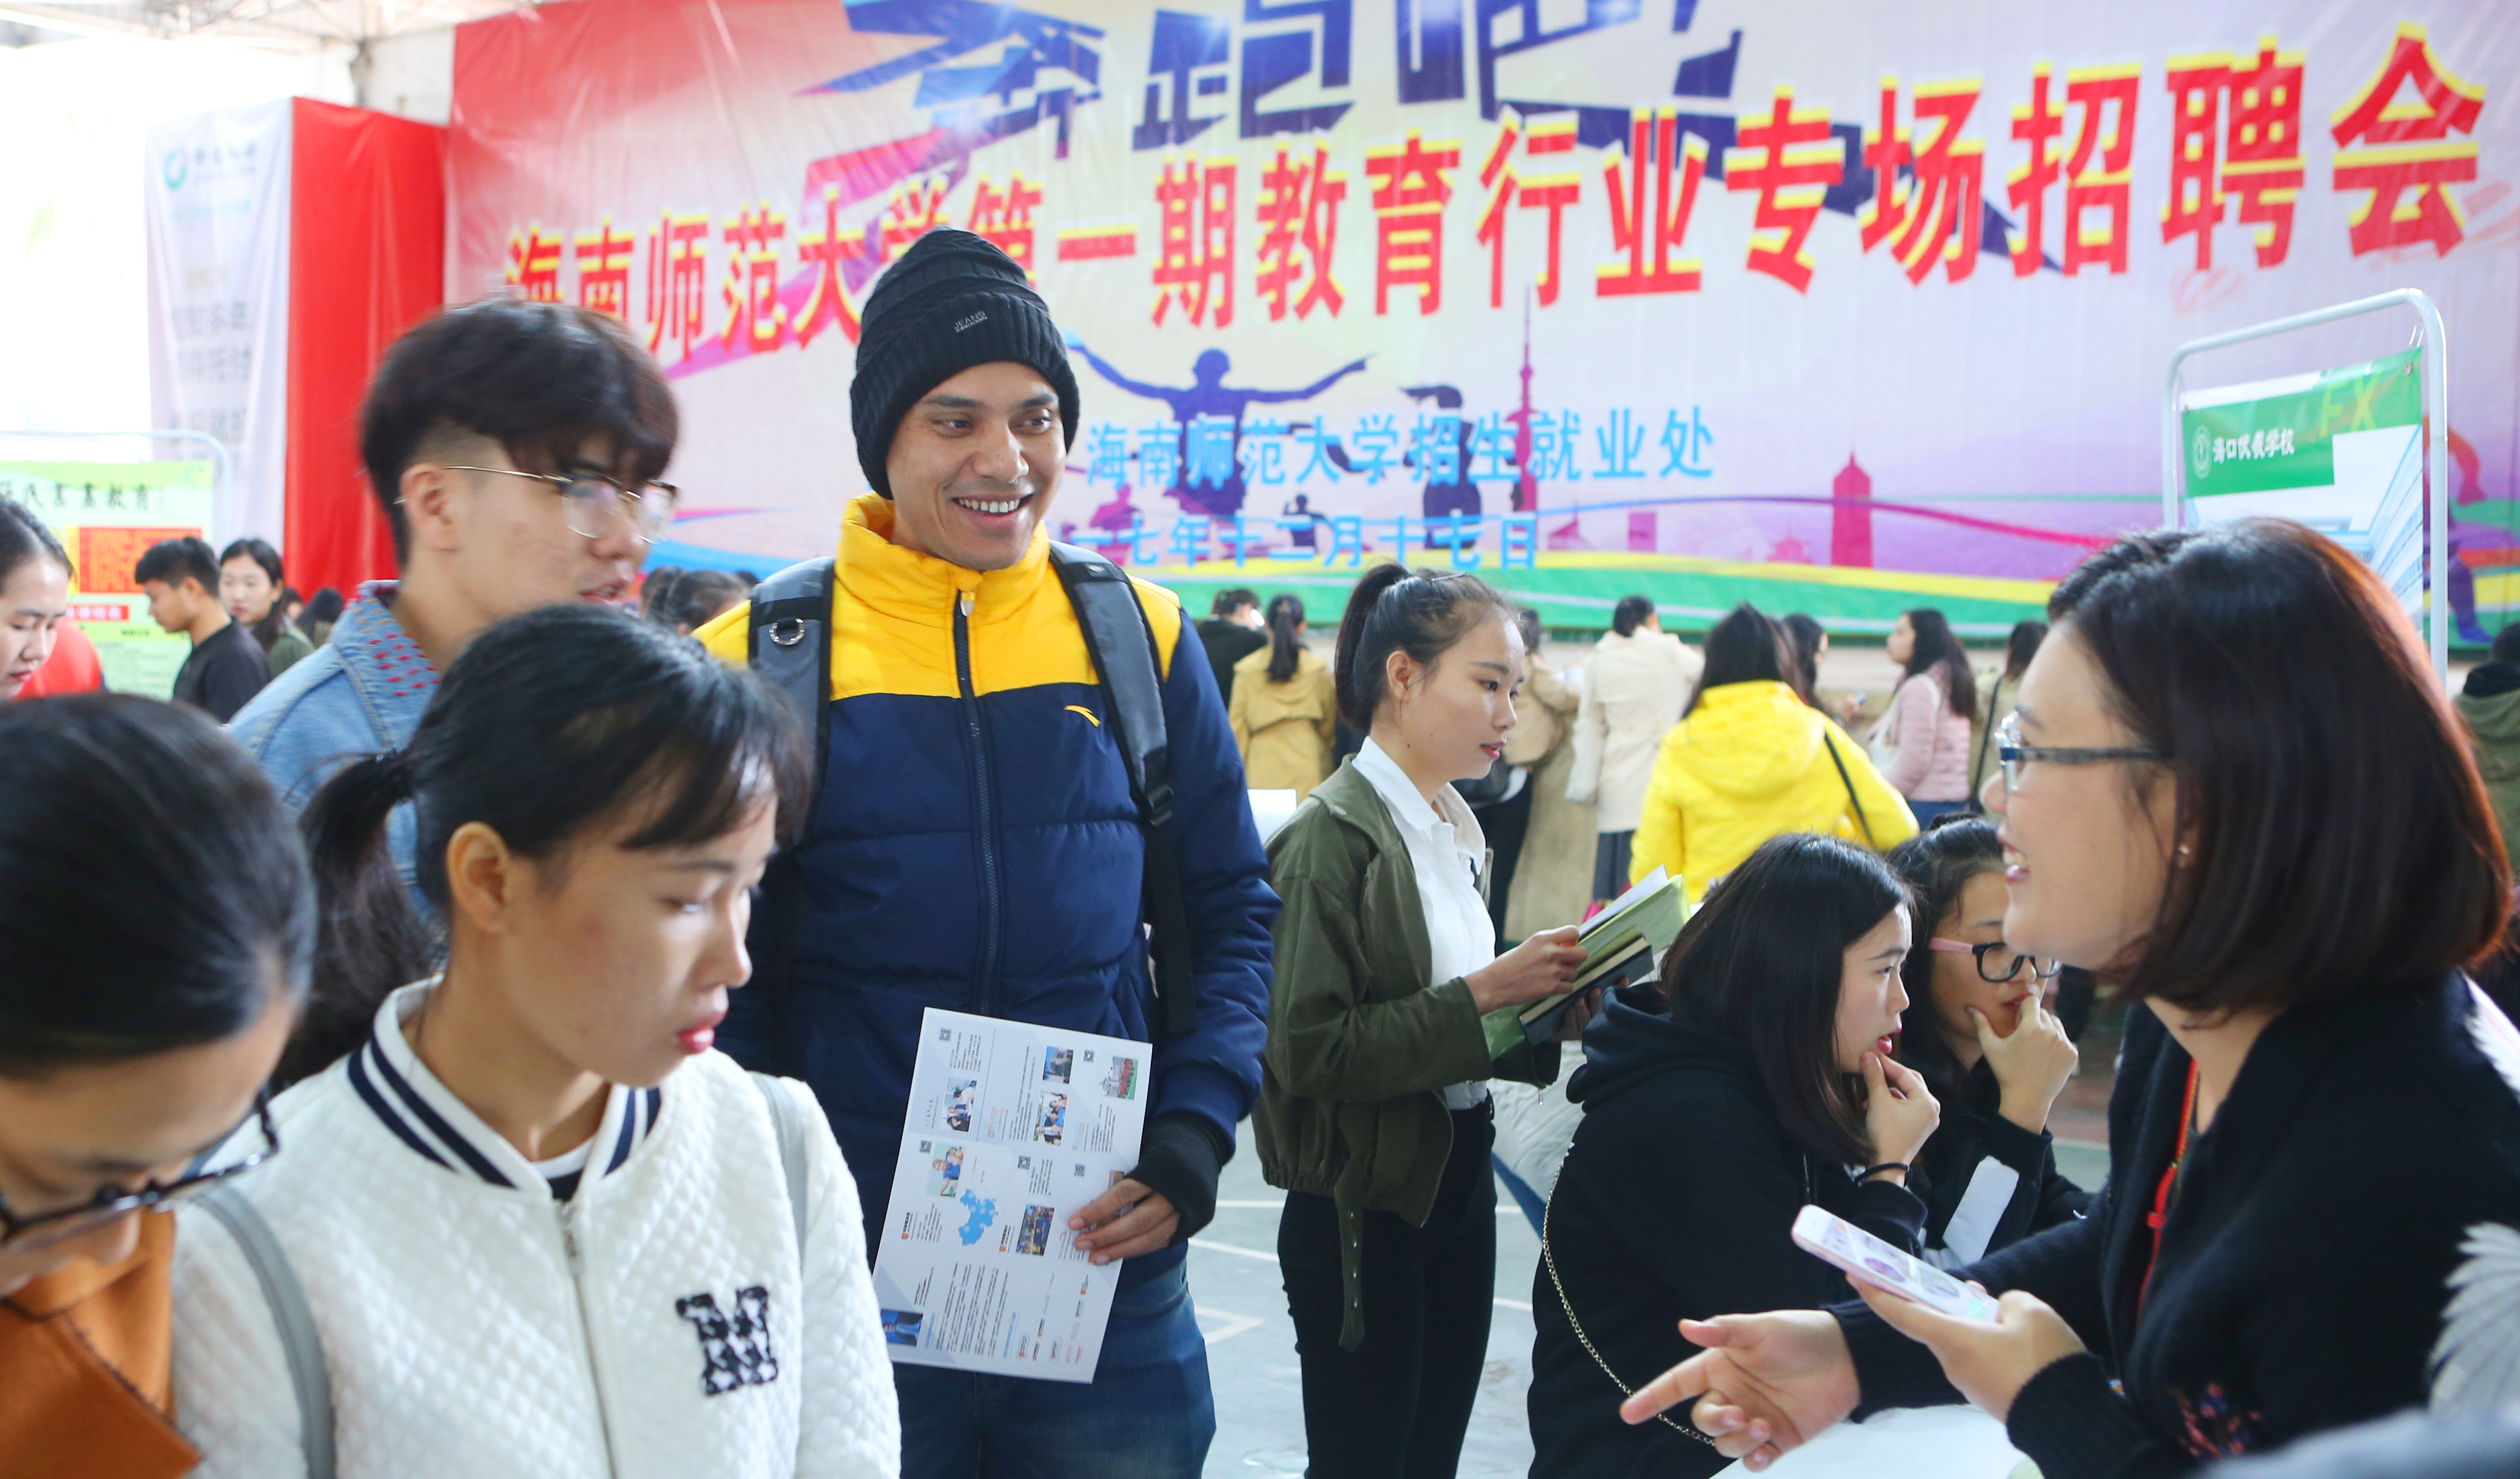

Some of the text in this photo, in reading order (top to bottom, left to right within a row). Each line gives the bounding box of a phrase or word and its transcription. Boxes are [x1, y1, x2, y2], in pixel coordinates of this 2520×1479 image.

[954, 310, 987, 332] JEANS
[1087, 405, 1715, 490] 海南师范大学招生就业处
[1070, 509, 1536, 569] 一七年十二月十七日
